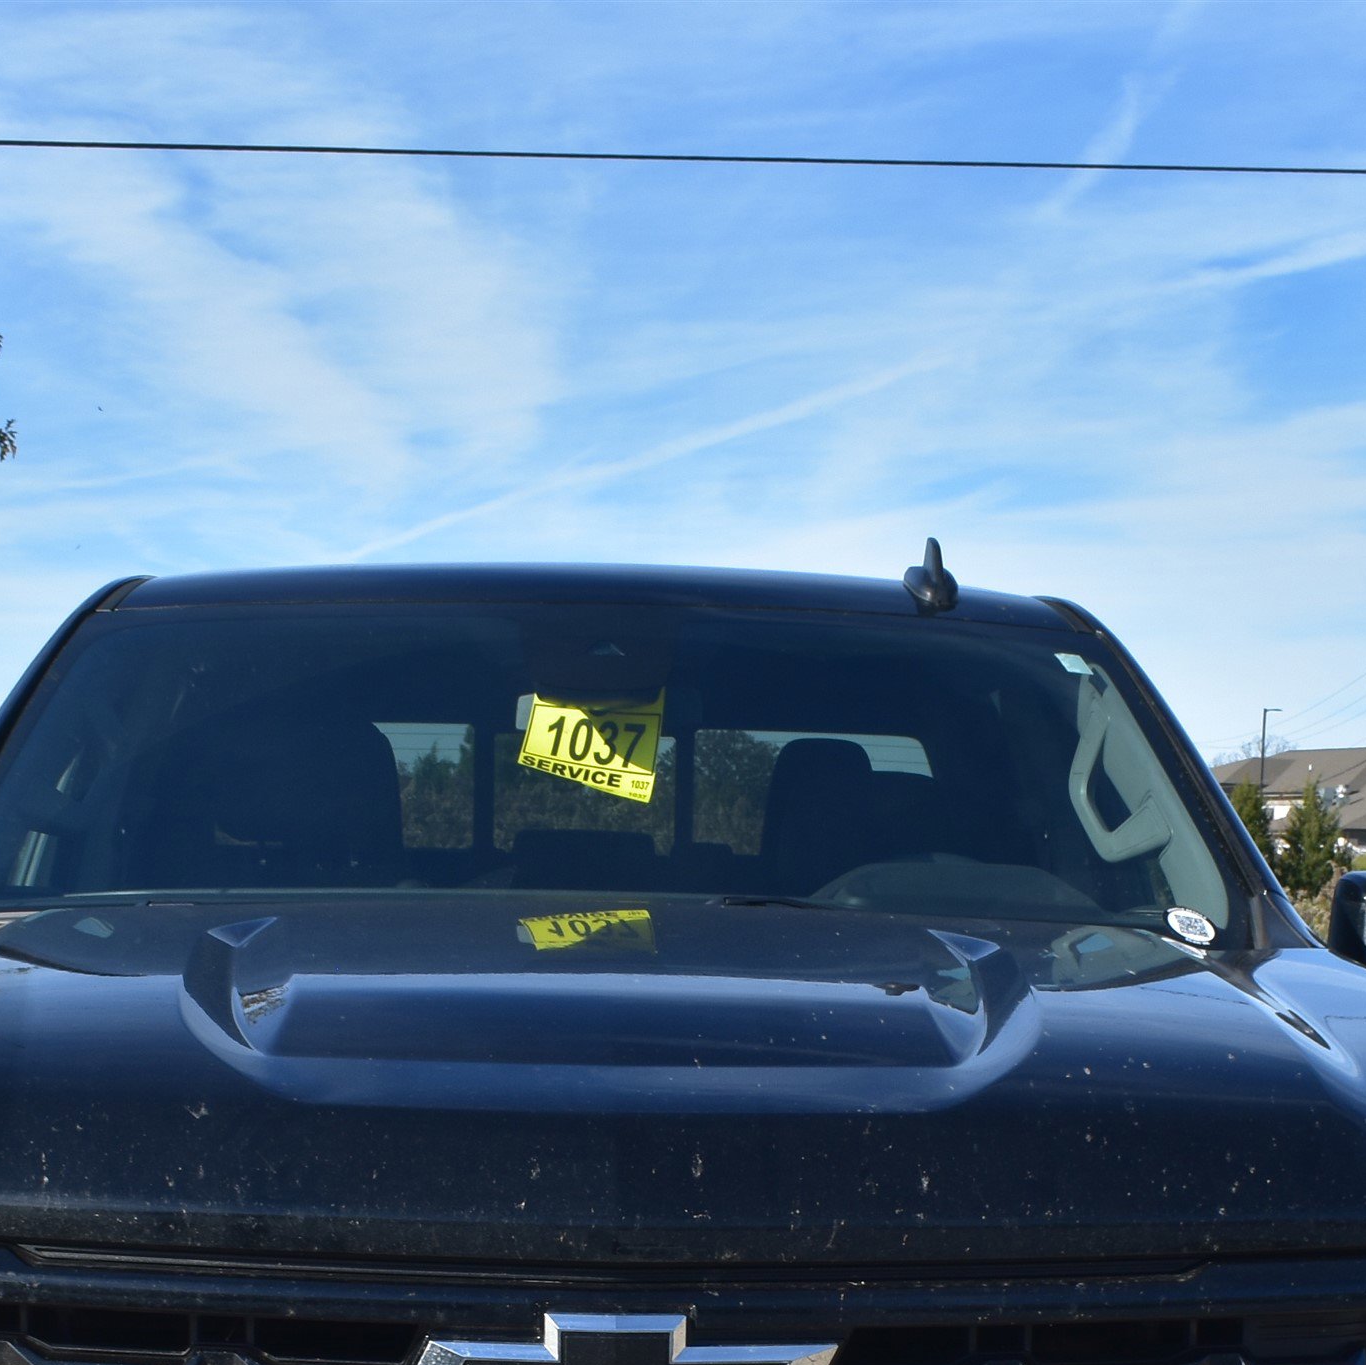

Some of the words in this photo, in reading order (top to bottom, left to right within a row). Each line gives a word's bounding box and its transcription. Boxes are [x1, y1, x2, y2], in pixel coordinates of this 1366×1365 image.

[547, 715, 647, 769] 1037
[521, 755, 623, 788] SERVICE
[631, 780, 650, 791] 1037
